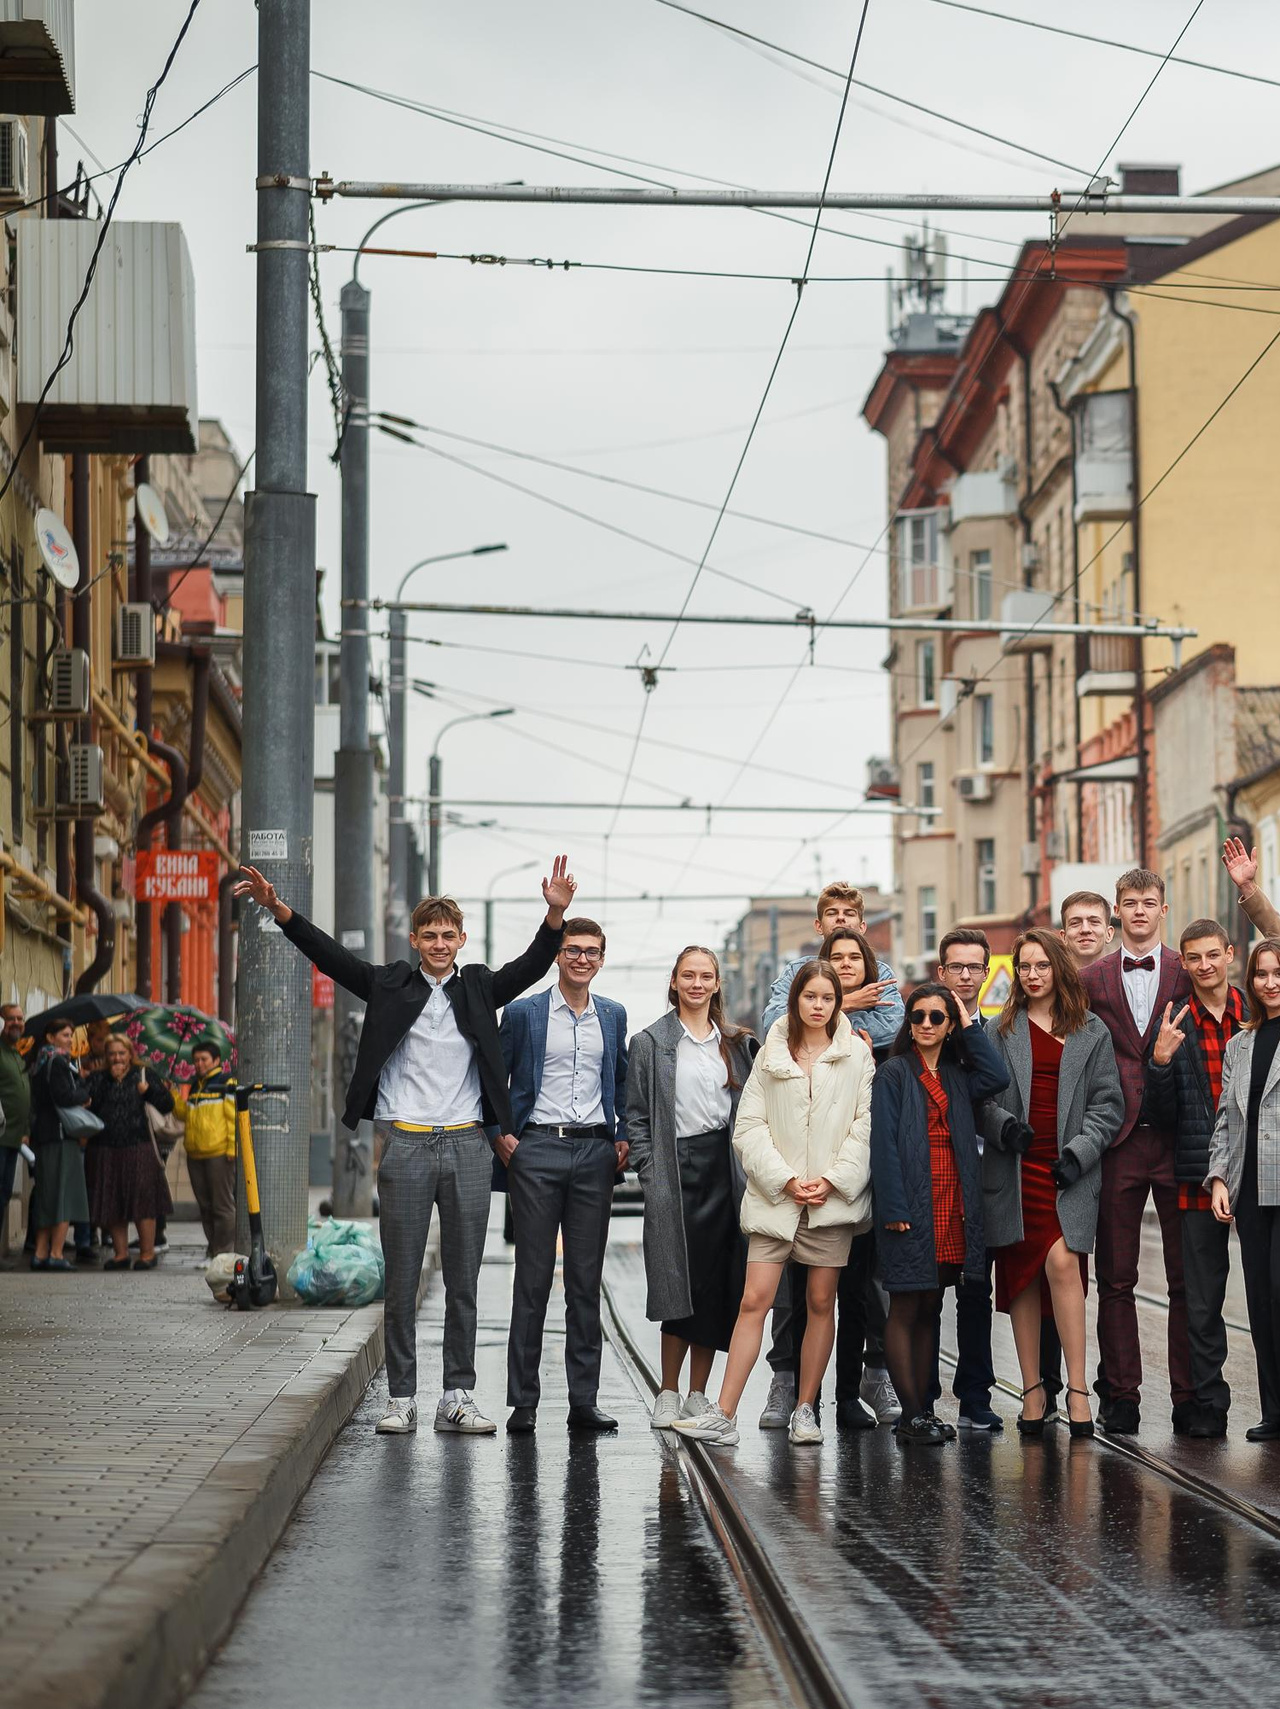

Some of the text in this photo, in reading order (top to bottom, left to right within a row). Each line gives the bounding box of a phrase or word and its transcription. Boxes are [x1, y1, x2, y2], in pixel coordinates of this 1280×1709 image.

[251, 832, 285, 841] РАБОТА
[156, 854, 198, 874] ВИНА
[146, 876, 208, 898] КУБАНИ
